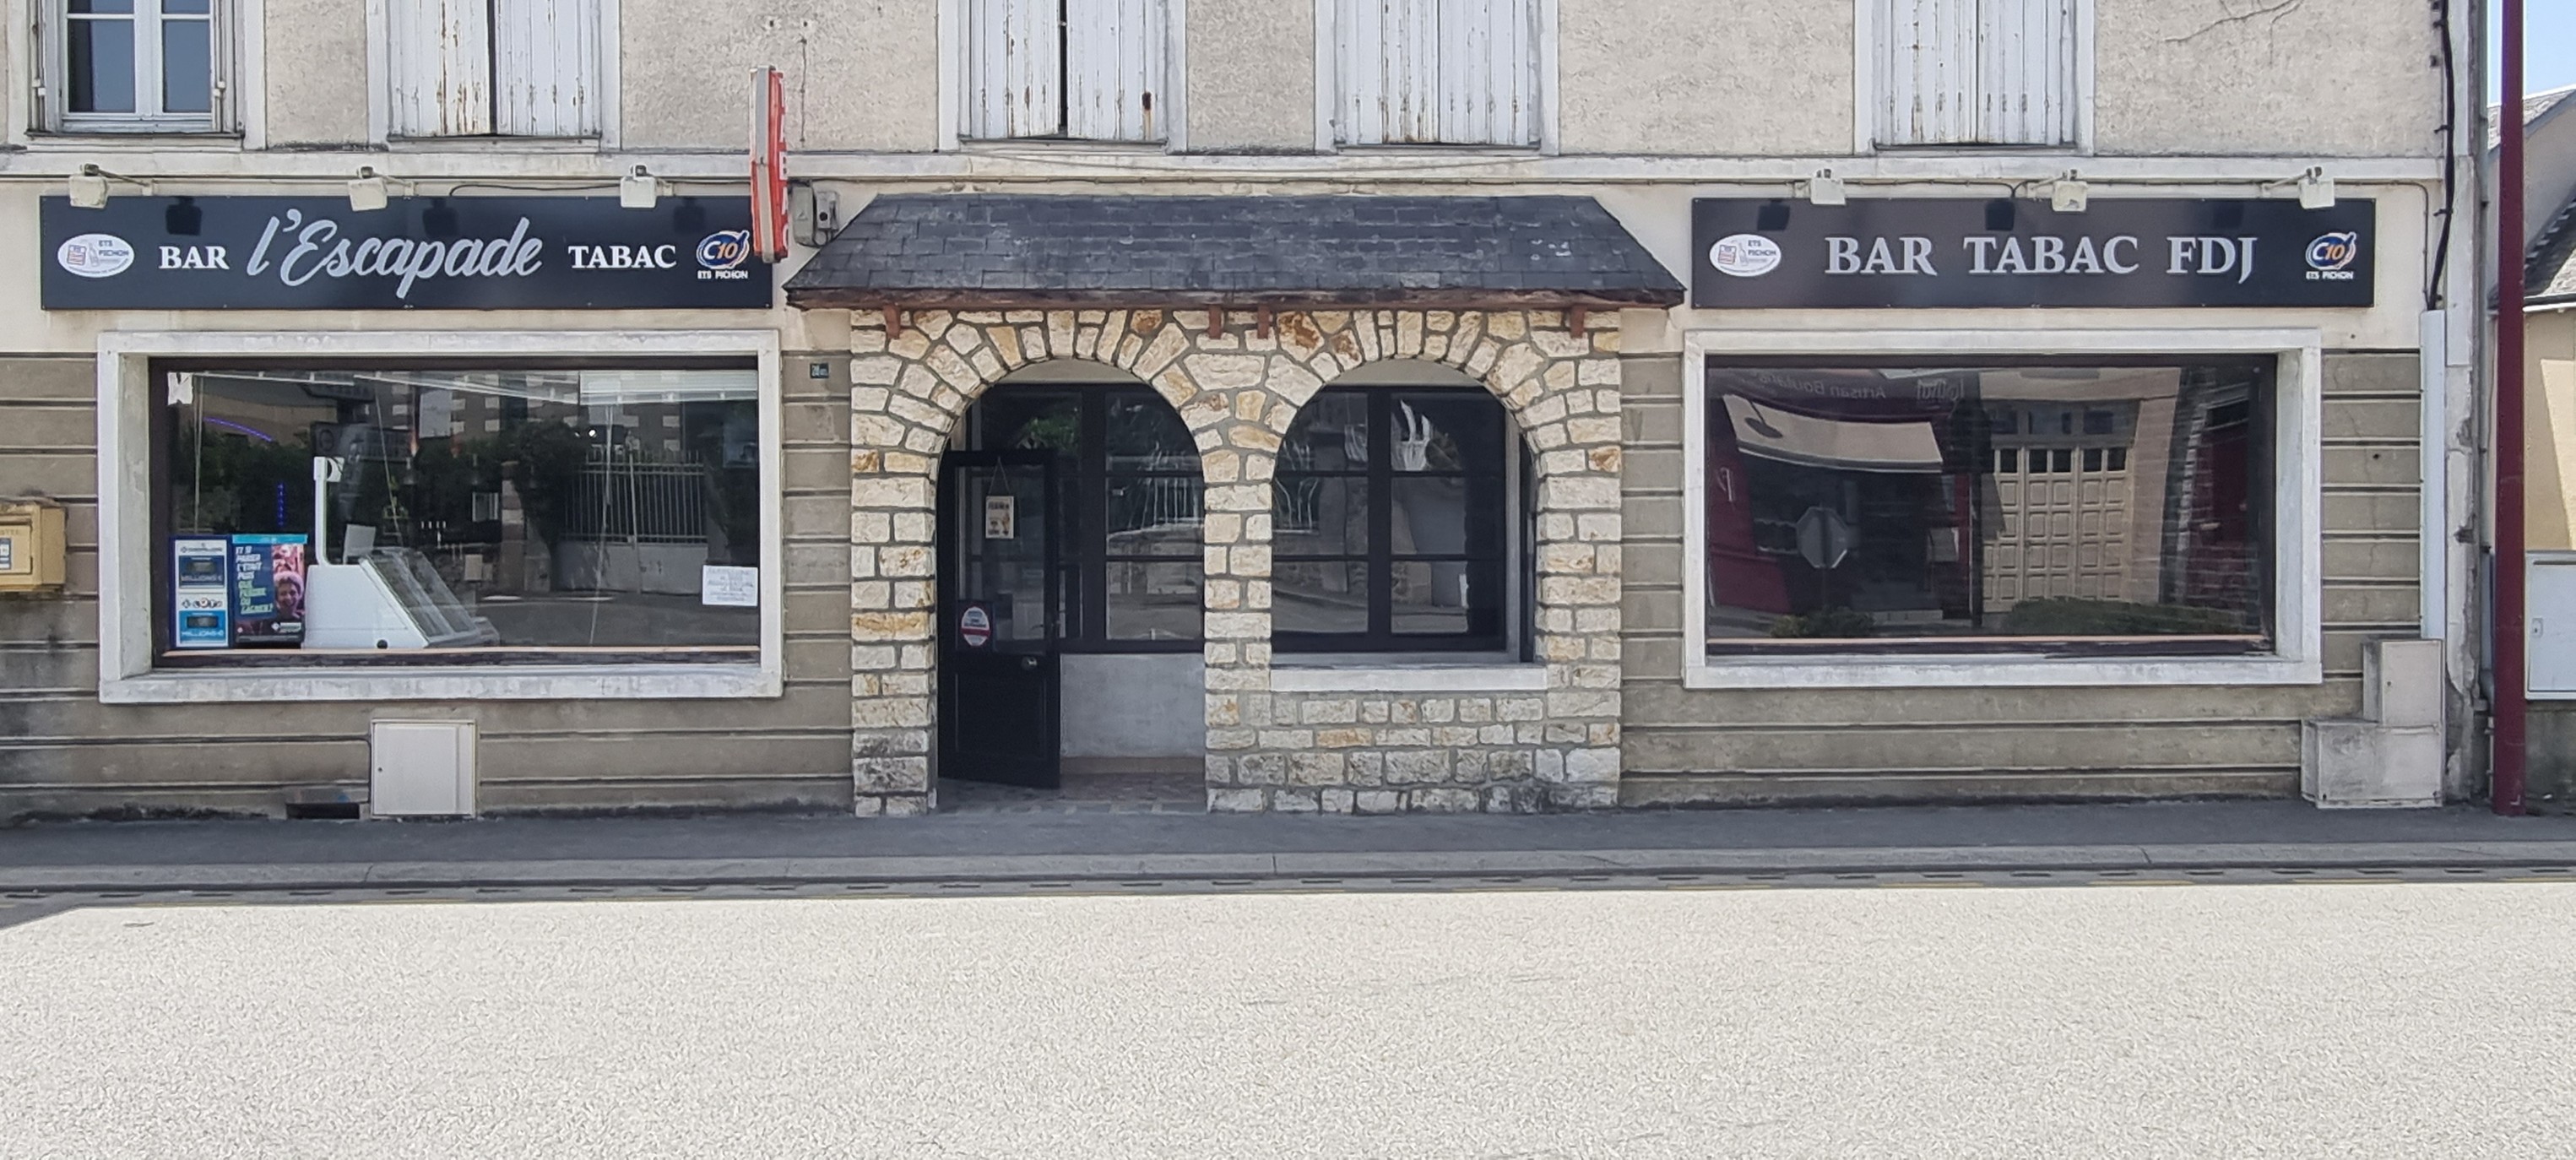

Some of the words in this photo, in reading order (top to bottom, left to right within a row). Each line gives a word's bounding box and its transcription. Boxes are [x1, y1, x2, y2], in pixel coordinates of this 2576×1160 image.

[159, 246, 230, 270] BAR
[247, 209, 543, 300] l'Escapade
[568, 245, 677, 269] TABAC
[702, 241, 739, 260] C10
[1825, 236, 1938, 276] BAR
[1963, 236, 2139, 276] TABAC
[2167, 236, 2259, 285] FDJ
[2312, 241, 2346, 261] C10
